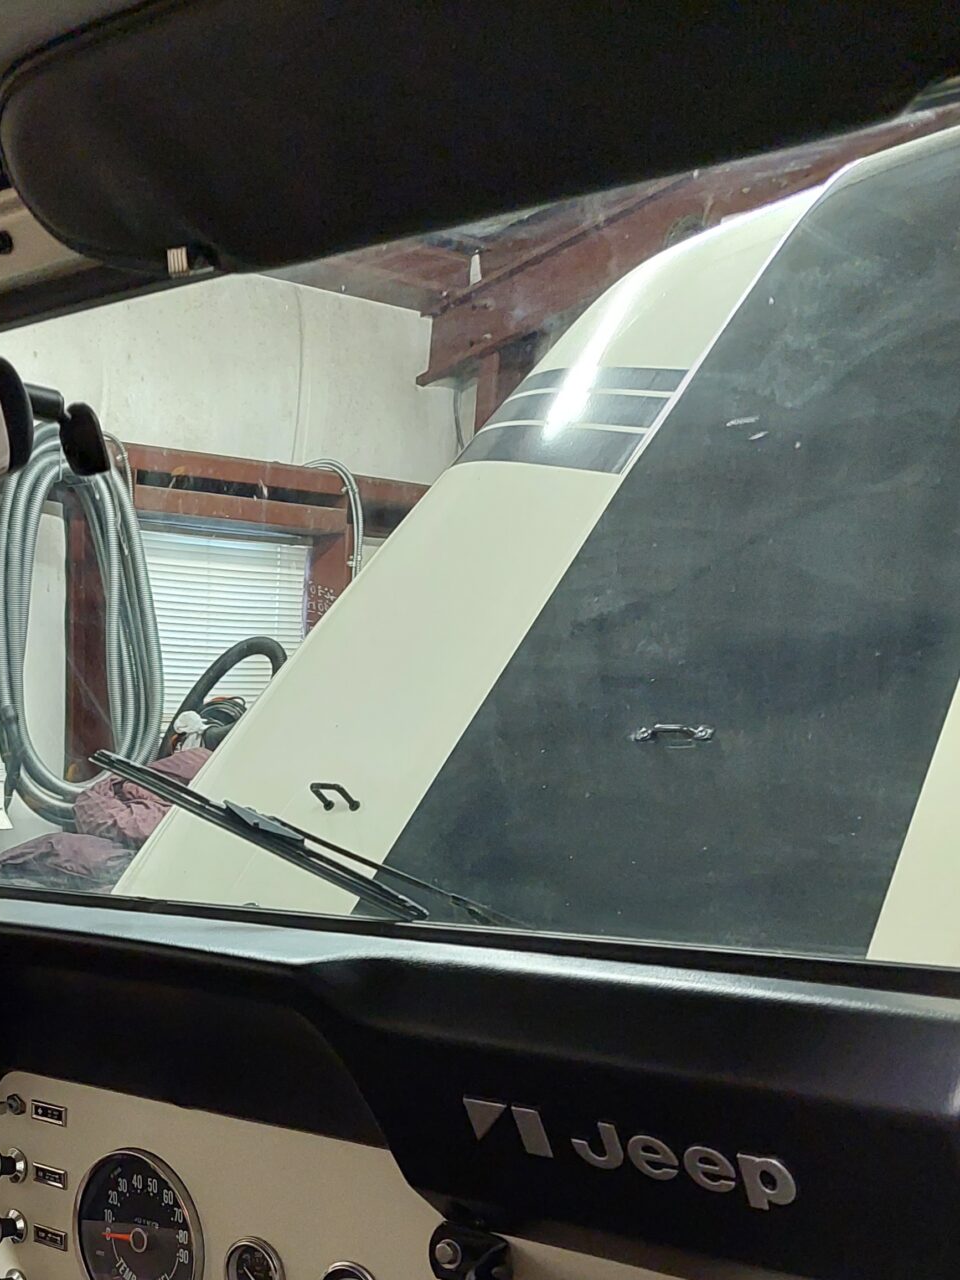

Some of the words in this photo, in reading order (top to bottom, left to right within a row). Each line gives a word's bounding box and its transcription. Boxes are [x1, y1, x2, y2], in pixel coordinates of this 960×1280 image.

[571, 1121, 797, 1211] Jeep
[118, 1178, 128, 1193] 30
[131, 1174, 143, 1189] 40
[147, 1178, 158, 1194] 50
[108, 1190, 118, 1205] 20
[163, 1189, 174, 1205] 60
[104, 1209, 113, 1223] 10
[173, 1207, 183, 1223] 70
[105, 1227, 111, 1240] 0
[178, 1230, 188, 1244] 80
[179, 1248, 189, 1264] 90
